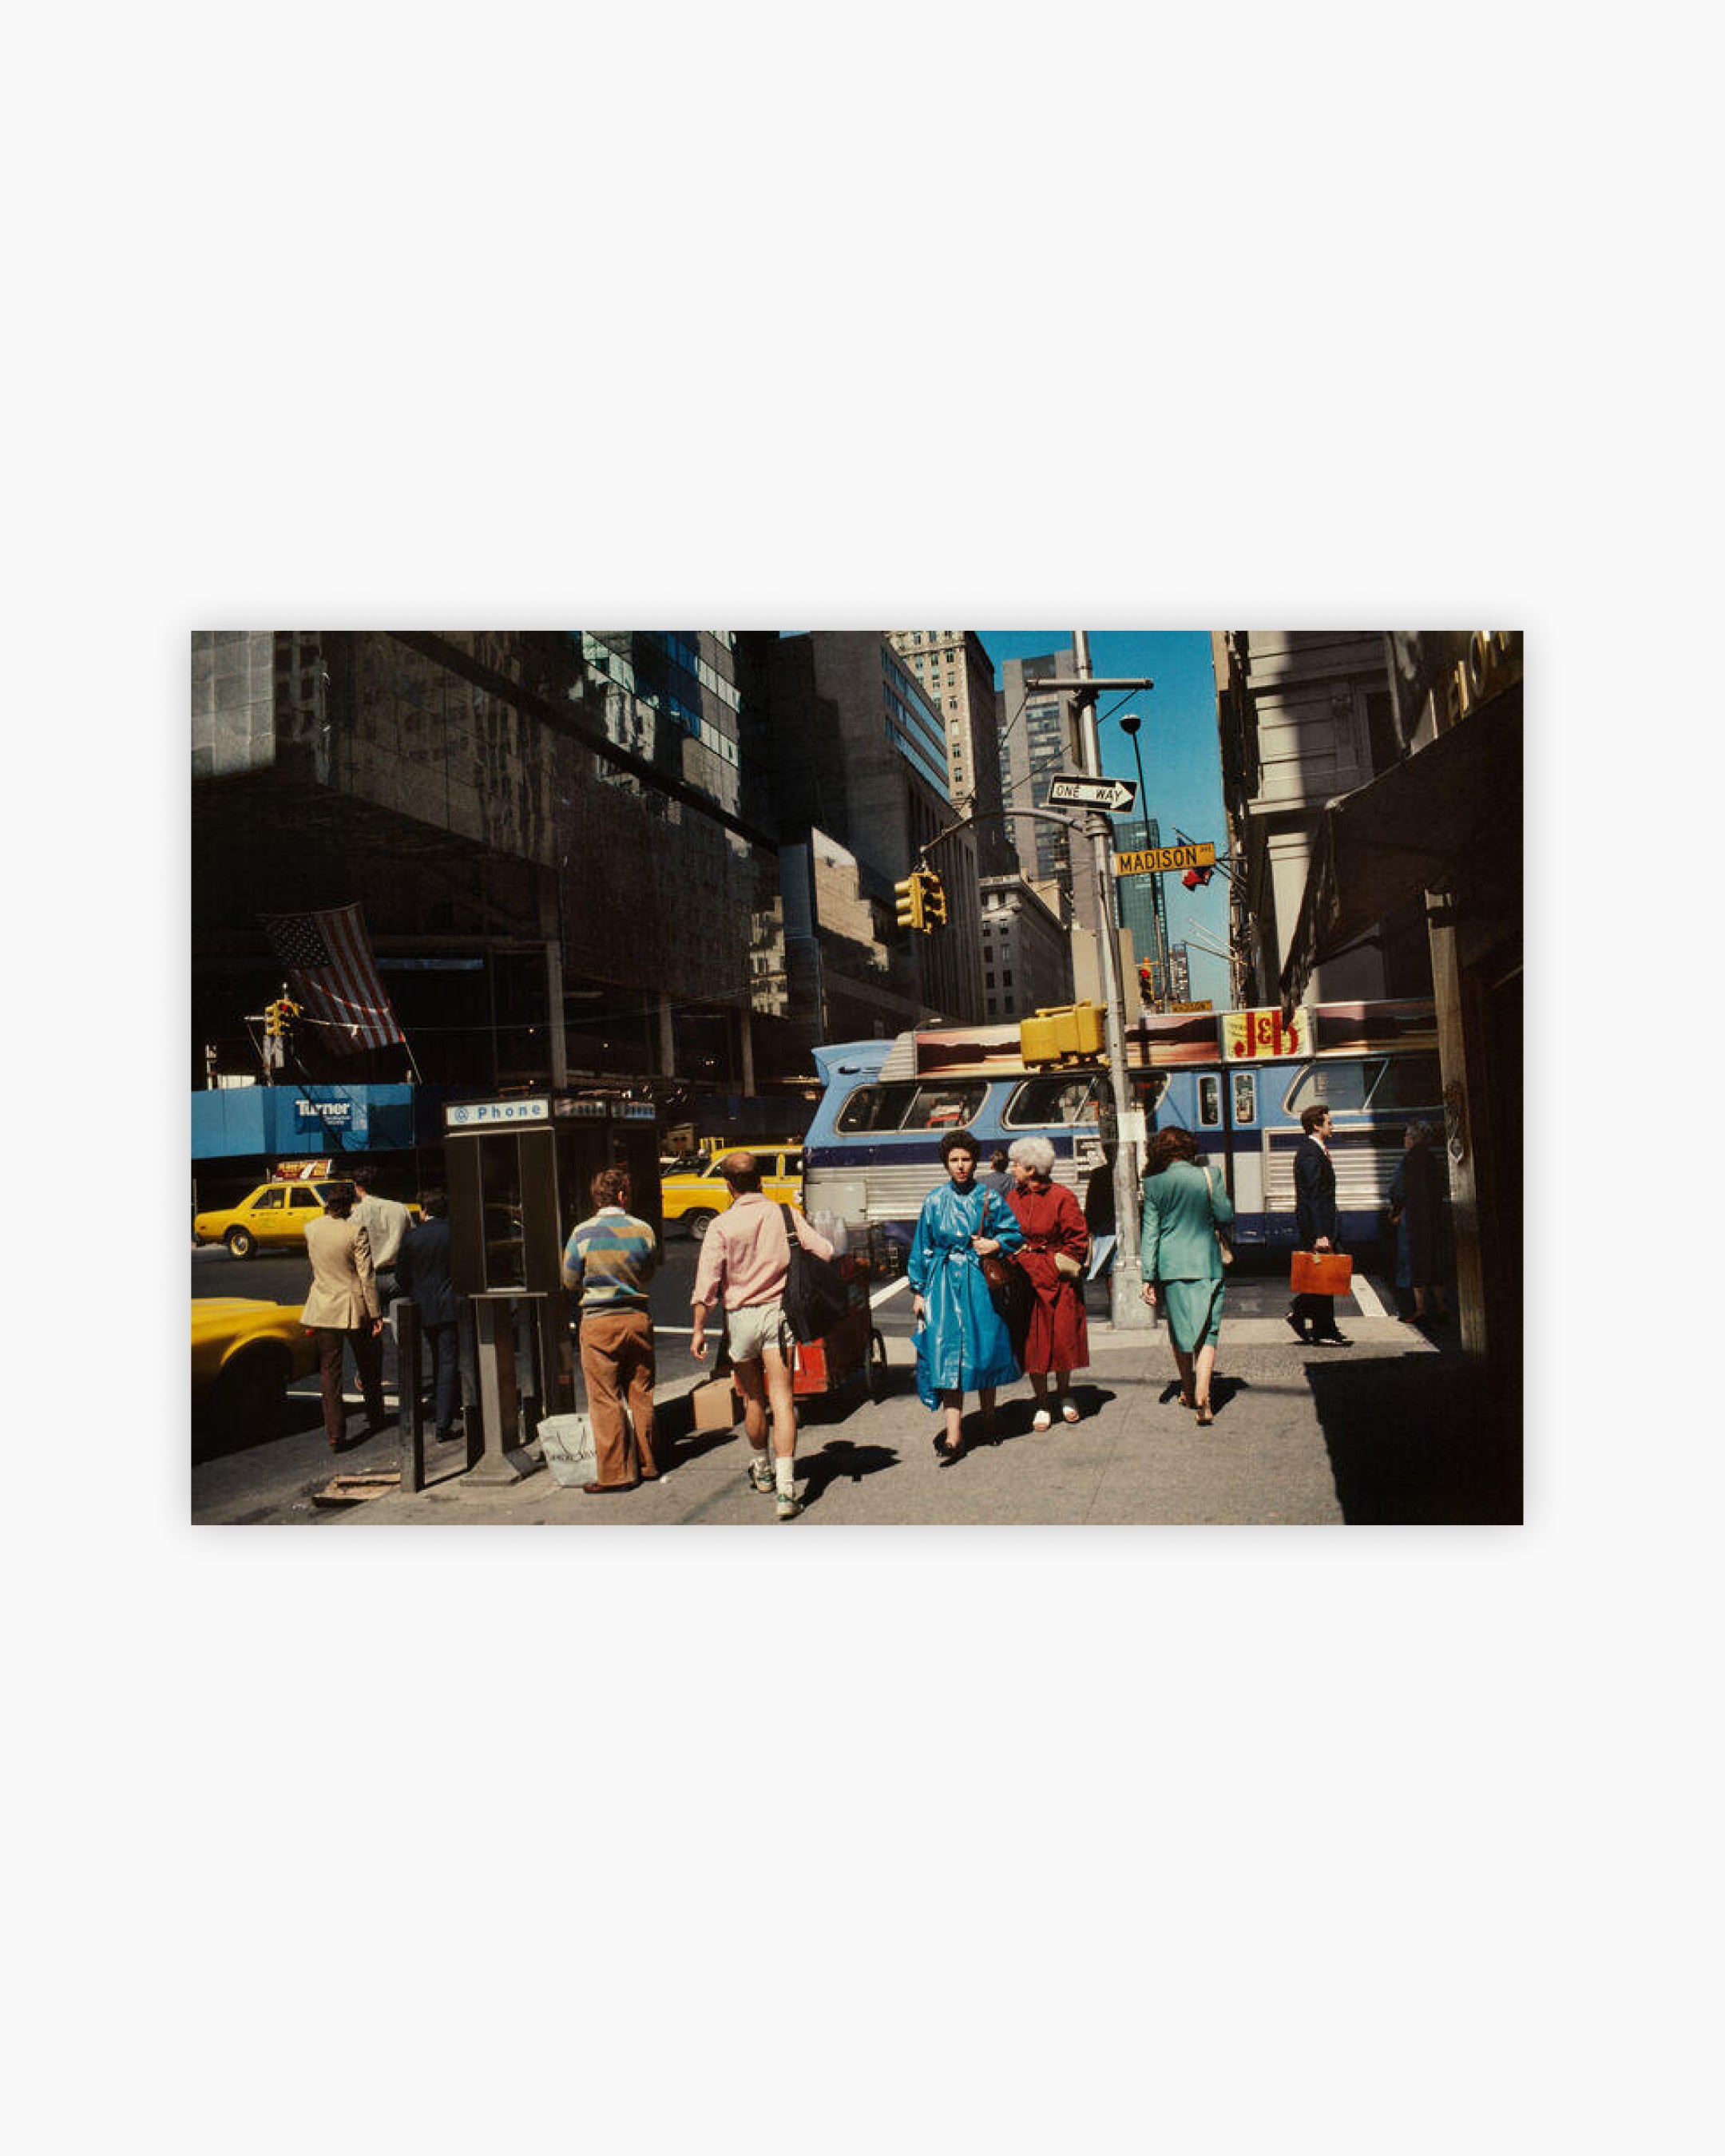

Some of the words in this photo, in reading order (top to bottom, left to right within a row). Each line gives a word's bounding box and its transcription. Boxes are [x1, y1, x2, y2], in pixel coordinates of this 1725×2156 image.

[1055, 785, 1081, 798] ONE
[1096, 788, 1124, 802] WAY
[1120, 847, 1197, 873] MADISON
[295, 1100, 350, 1116] Turner
[477, 1104, 541, 1120] Phone
